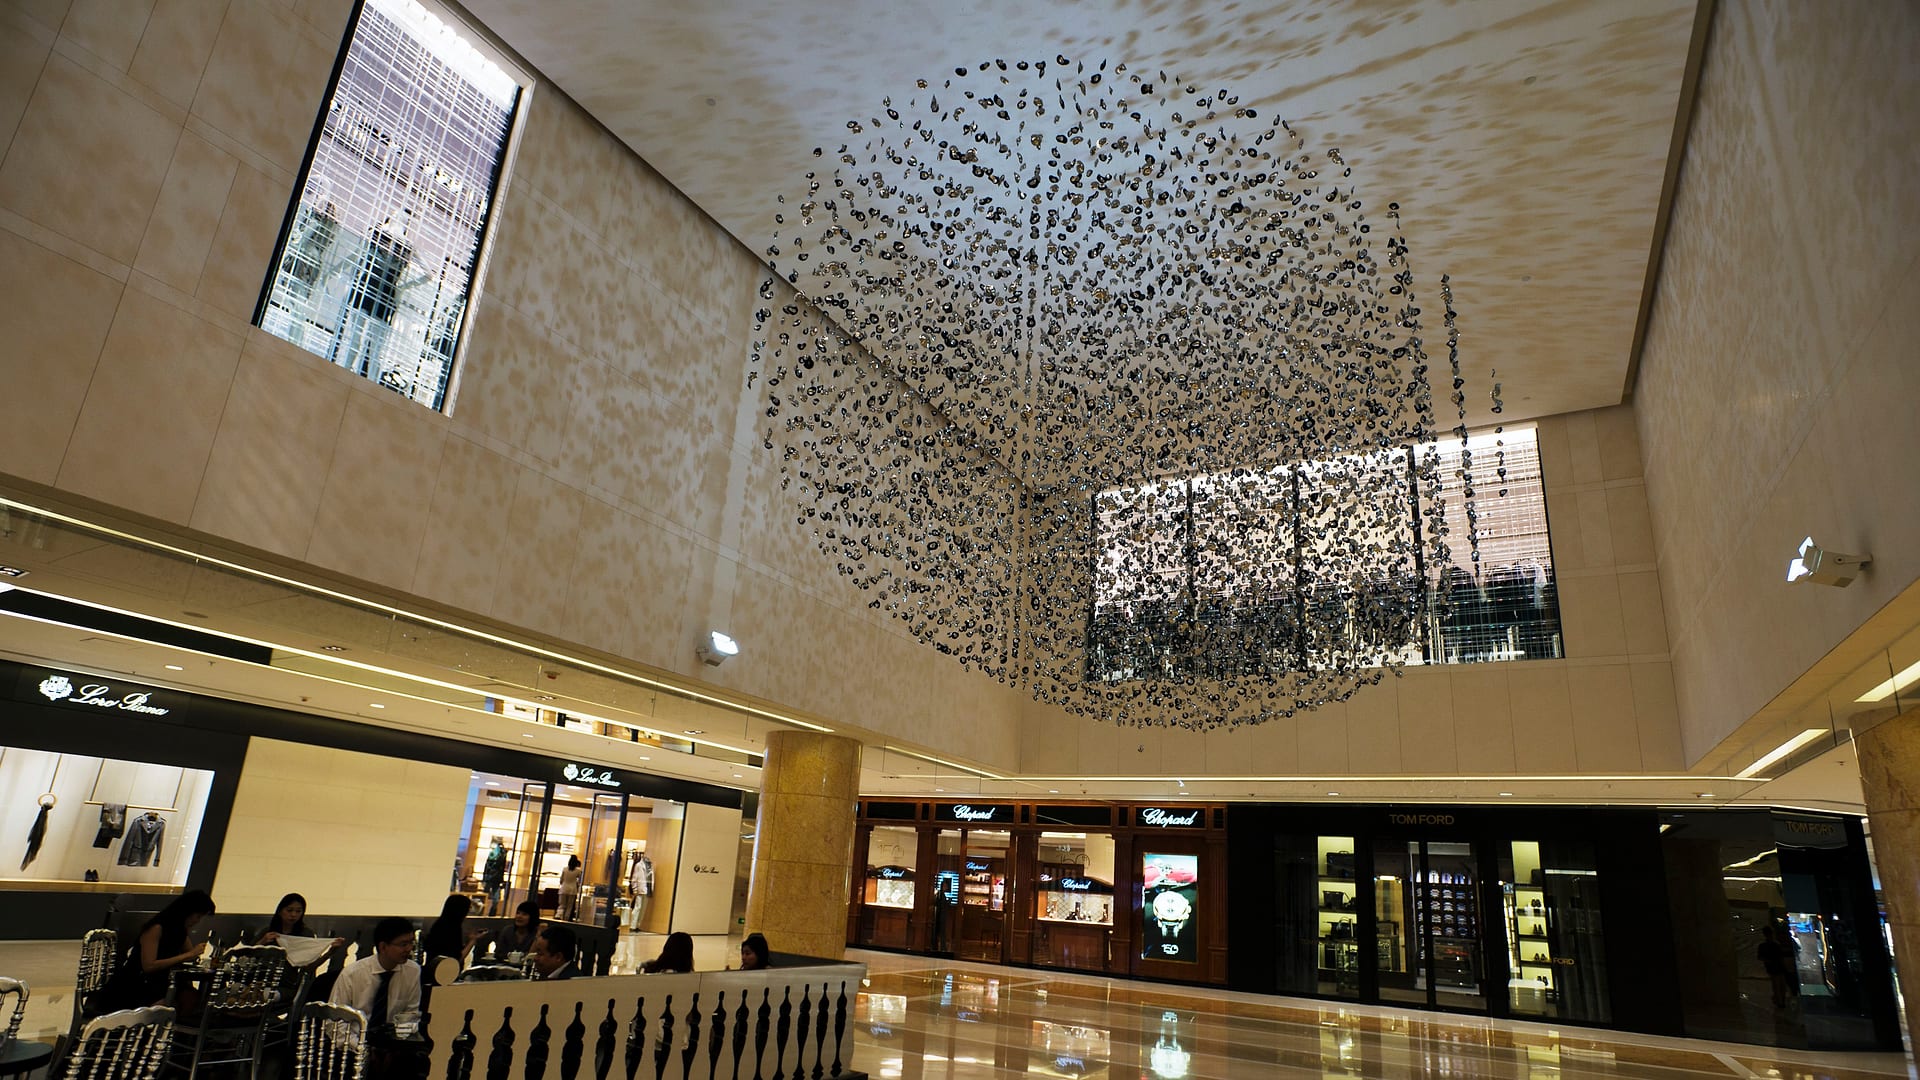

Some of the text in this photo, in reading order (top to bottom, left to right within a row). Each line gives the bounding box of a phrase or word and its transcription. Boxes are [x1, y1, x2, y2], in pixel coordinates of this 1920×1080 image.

[69, 684, 170, 716] Loro Piana
[953, 804, 996, 822] Chopard
[1142, 808, 1198, 828] Chopard
[1388, 813, 1455, 825] TOM FORD
[966, 861, 989, 871] Chopard
[1061, 878, 1092, 891] Chopard
